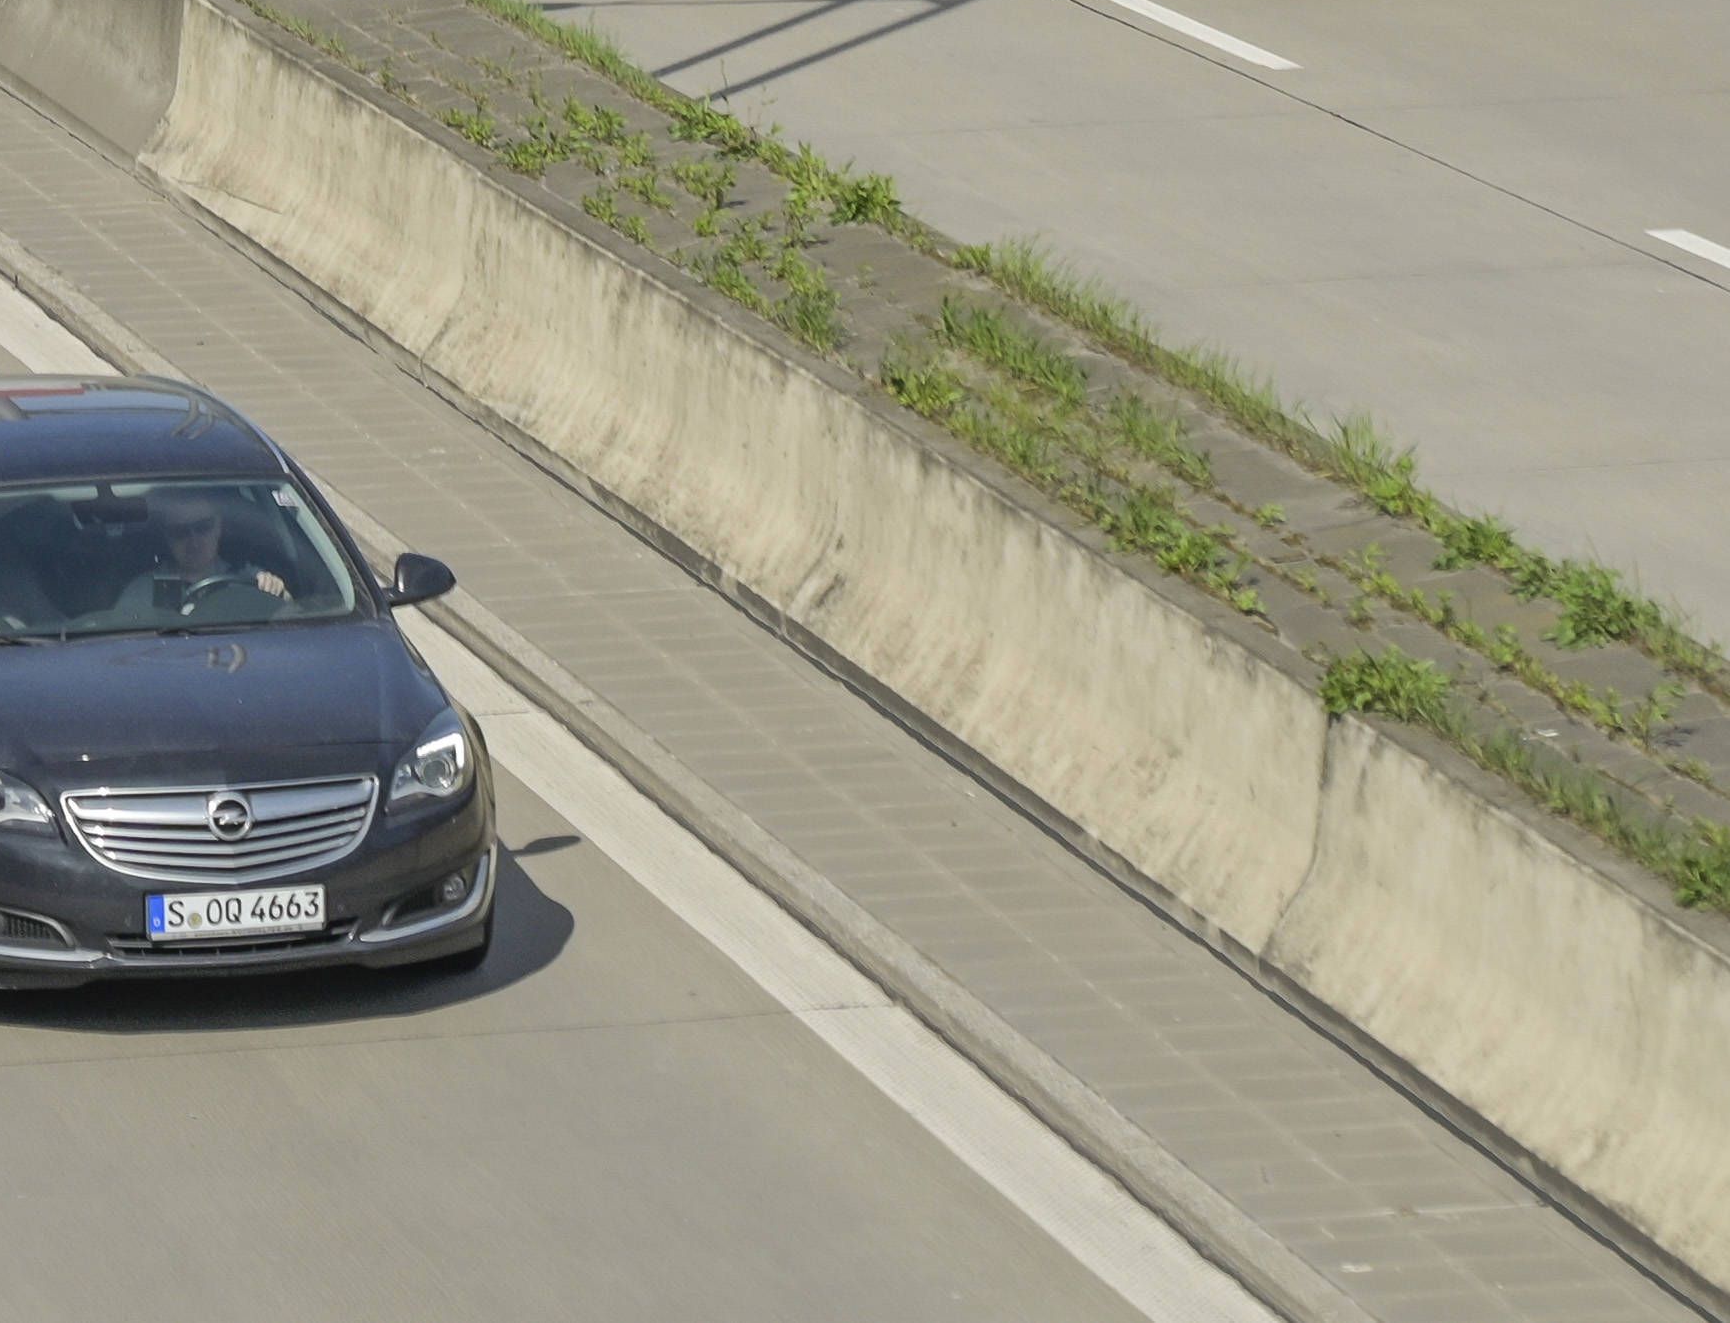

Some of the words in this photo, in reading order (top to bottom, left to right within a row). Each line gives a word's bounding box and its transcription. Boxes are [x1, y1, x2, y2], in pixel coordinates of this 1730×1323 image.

[168, 900, 186, 928] S
[207, 897, 244, 927] OQ
[251, 892, 320, 923] 4663
